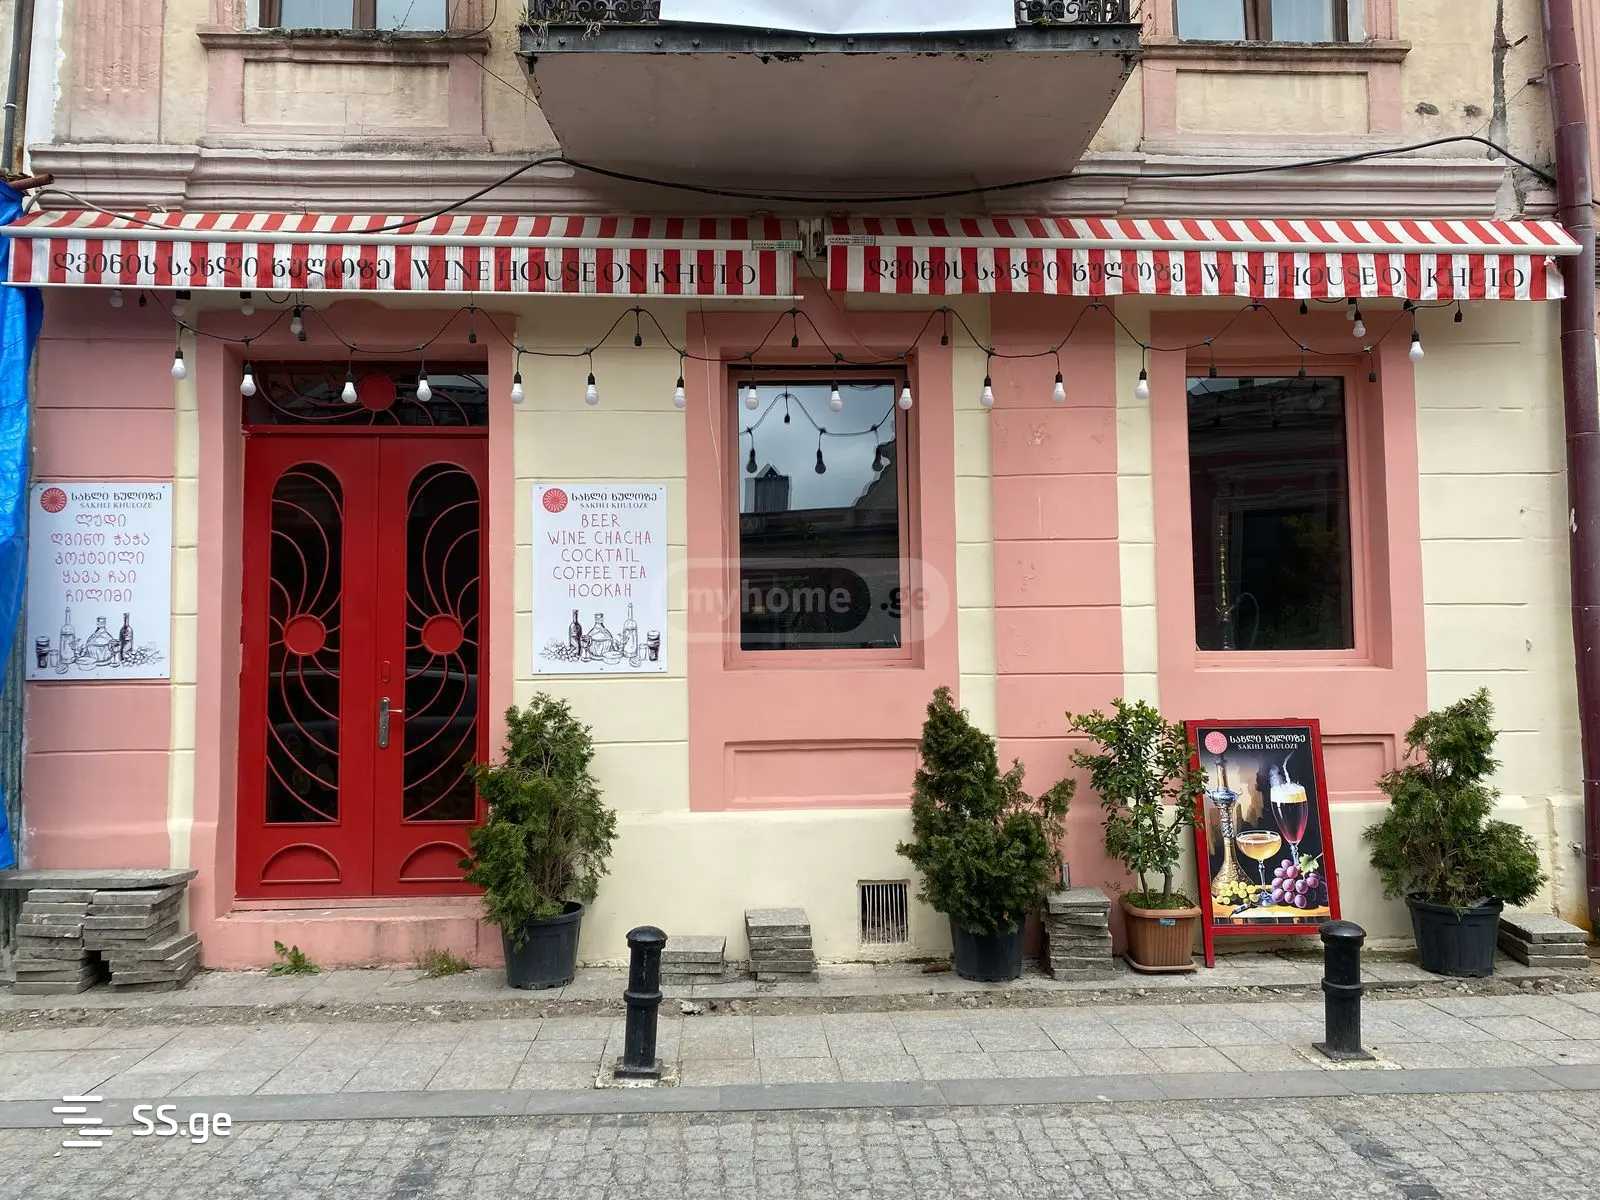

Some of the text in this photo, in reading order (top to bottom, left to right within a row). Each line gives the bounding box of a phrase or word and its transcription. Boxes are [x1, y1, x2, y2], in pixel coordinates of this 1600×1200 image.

[54, 251, 391, 281] ღვინის სახლი ხულოზე
[413, 258, 757, 286] WINE HOUSE ON KHULO
[868, 257, 1184, 284] ღვინის სახლი ხულოზე
[1203, 262, 1525, 289] WINE HOUSE ON KHULO
[71, 491, 162, 502] სახლი ხულოზე
[571, 492, 658, 502] სახლი ხულოზე
[75, 513, 127, 528] ლუდი
[580, 513, 621, 529] BEER
[50, 532, 151, 547] ღვინო ჭაჭა
[547, 530, 653, 546] WINE CHACHA
[55, 550, 145, 566] კოქტეილი
[561, 547, 640, 563] COCKTAIL
[62, 569, 137, 584] ყავა ჩაი
[552, 565, 647, 580] COFFEE TEA
[65, 588, 132, 603] ჩილიმი
[568, 583, 633, 598] HOOKAH
[1229, 734, 1306, 744] სახლი ხულოზე
